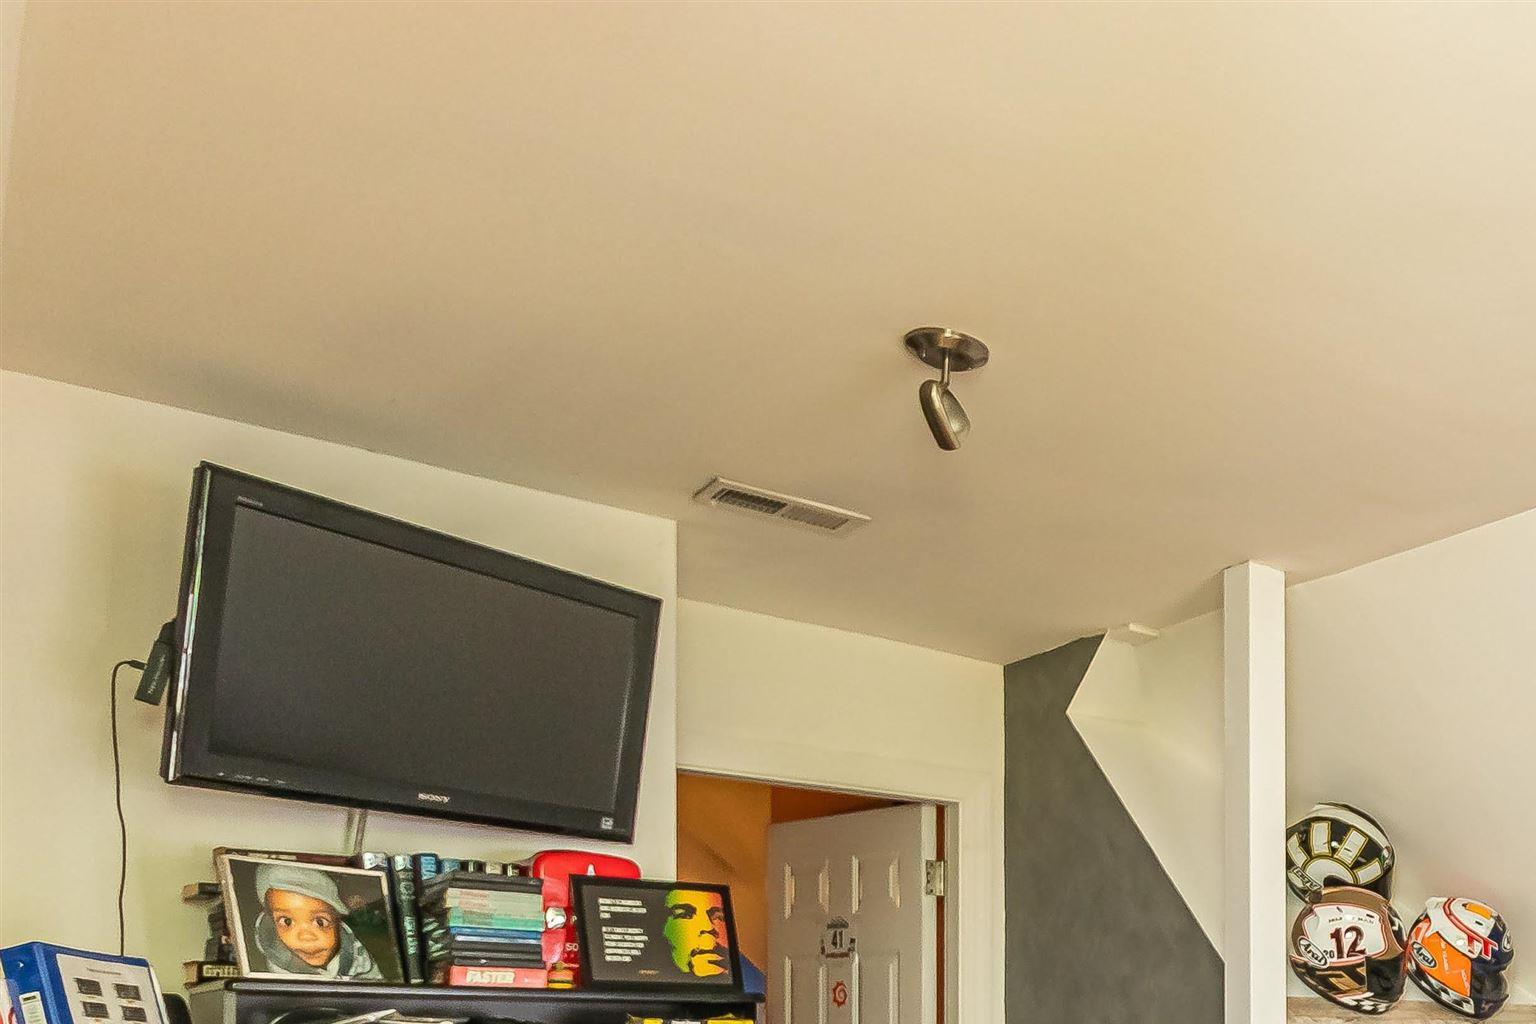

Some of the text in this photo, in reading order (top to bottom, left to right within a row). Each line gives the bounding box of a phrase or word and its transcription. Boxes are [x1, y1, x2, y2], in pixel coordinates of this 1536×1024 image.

[417, 793, 450, 803] SONY
[1330, 925, 1367, 960] 12
[1299, 941, 1325, 963] Arai
[466, 971, 515, 984] FASTER
